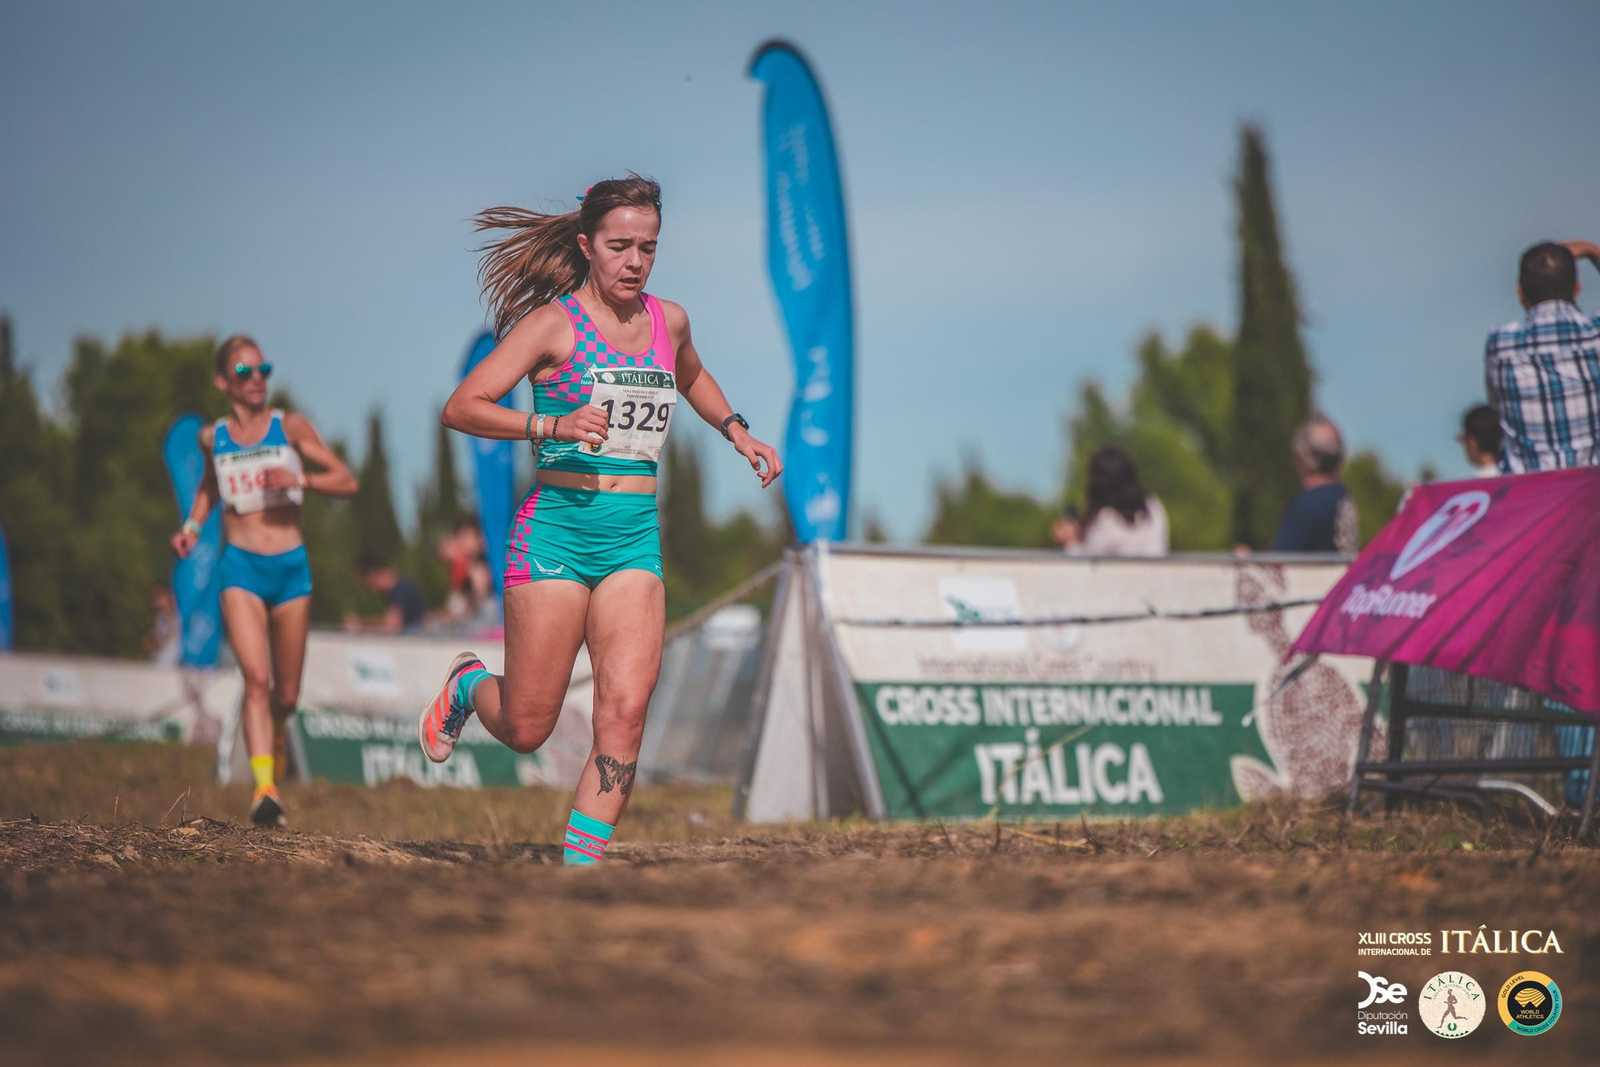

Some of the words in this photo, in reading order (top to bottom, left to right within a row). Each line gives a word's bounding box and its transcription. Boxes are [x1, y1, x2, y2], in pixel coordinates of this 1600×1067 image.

[621, 372, 659, 385] ITÁLICA
[600, 398, 670, 433] 1329
[1340, 583, 1438, 623] TopRunner
[875, 686, 982, 726] CROSS
[982, 686, 1224, 727] INTERNACIONAL
[974, 727, 1165, 805] ITÁLICA
